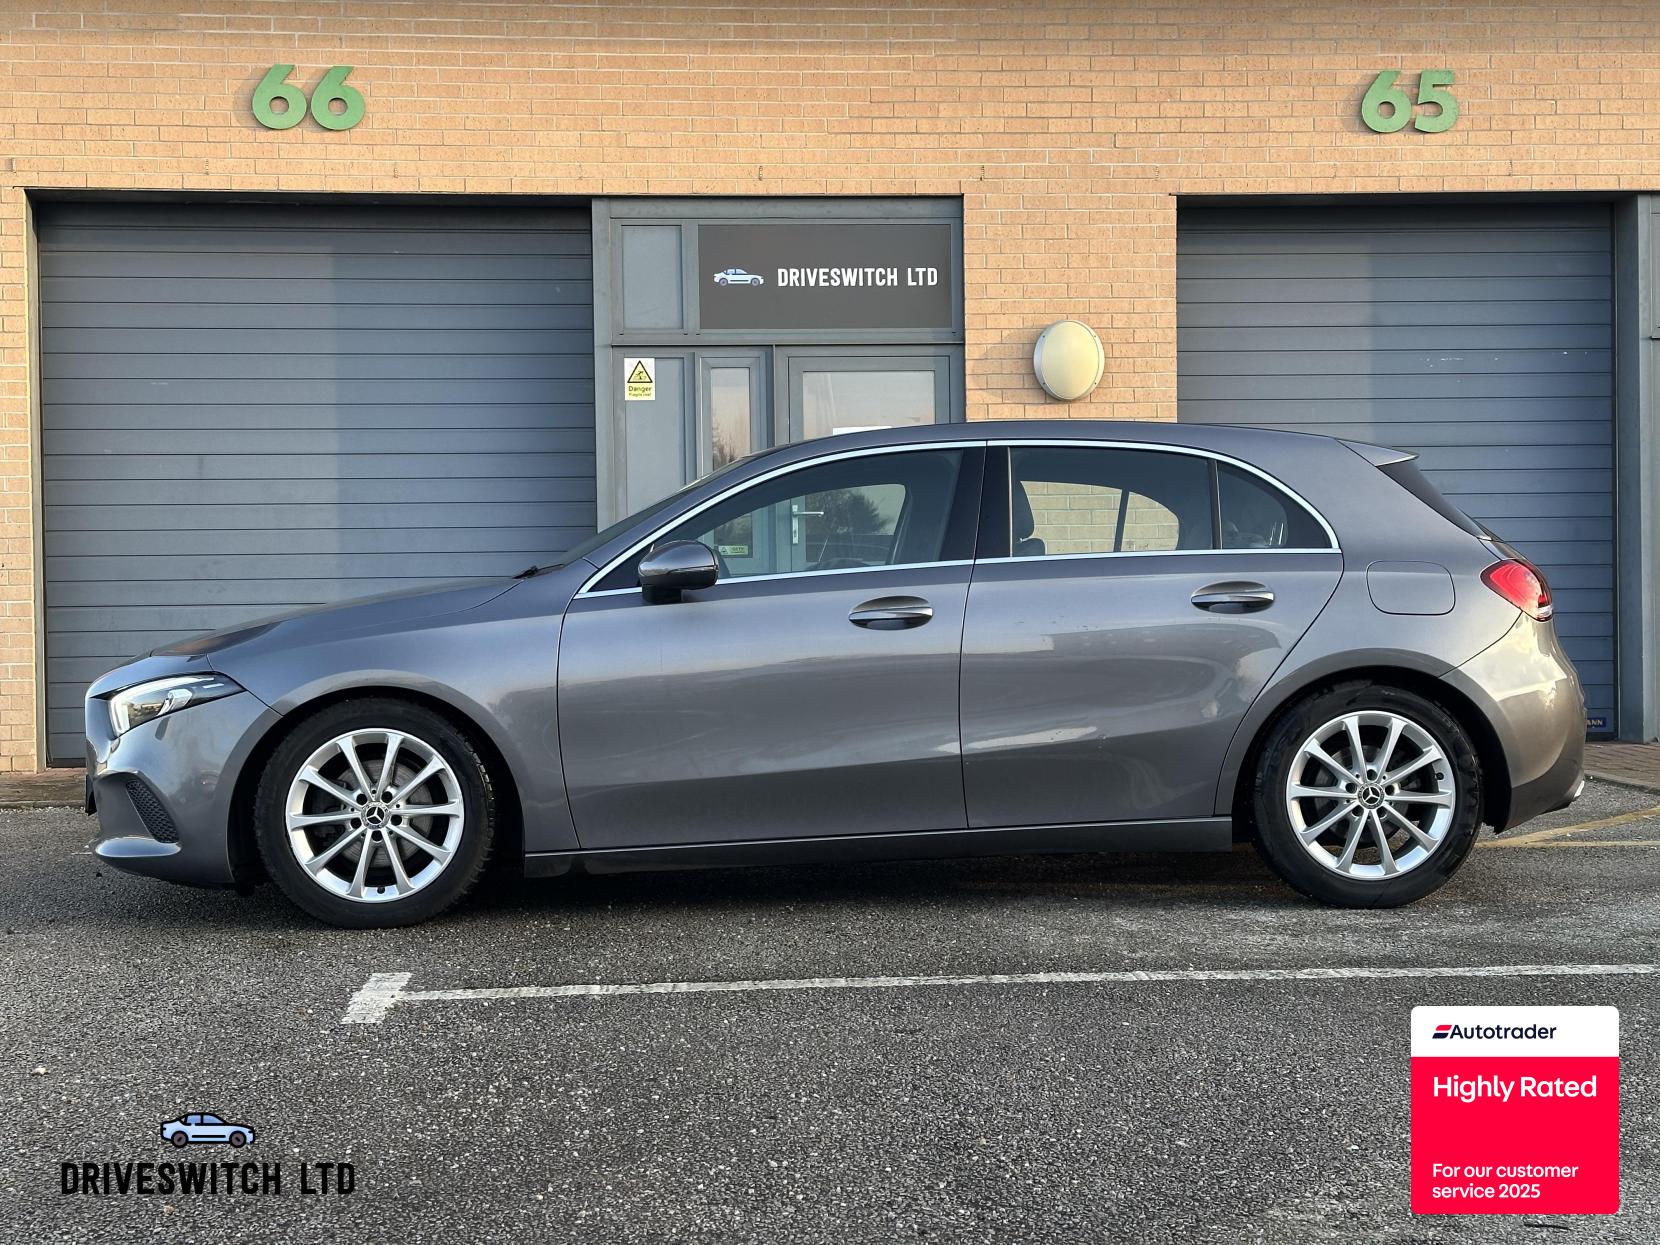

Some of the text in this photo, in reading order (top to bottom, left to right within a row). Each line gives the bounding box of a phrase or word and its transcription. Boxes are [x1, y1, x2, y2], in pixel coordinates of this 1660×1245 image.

[251, 64, 366, 131] 66
[1361, 70, 1460, 133] 65
[777, 267, 938, 287] DRIVESWITCH LTD
